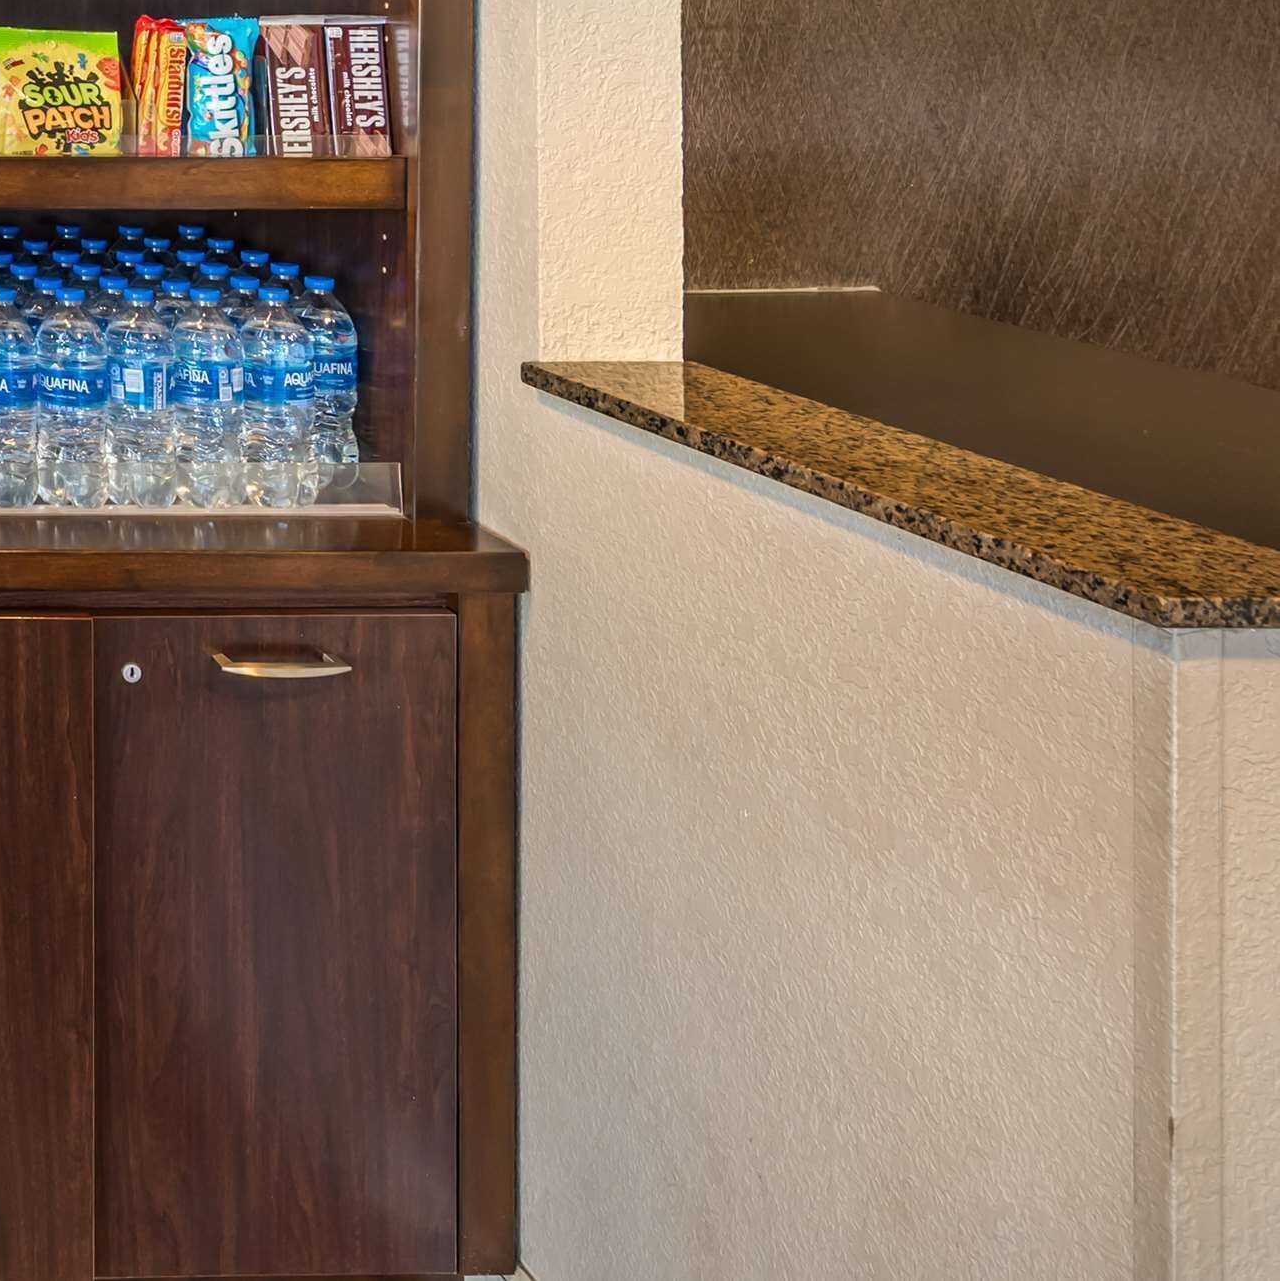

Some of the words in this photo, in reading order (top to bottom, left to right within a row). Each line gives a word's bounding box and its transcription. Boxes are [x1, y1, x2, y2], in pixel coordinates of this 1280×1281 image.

[166, 47, 186, 123] Starburst
[308, 68, 317, 105] chocolate
[342, 72, 351, 88] milk
[349, 30, 385, 127] HERSHEY'S
[23, 83, 102, 107] SOUR
[344, 90, 353, 126] chocolate
[23, 106, 112, 135] PATCH
[311, 105, 319, 122] milk
[65, 129, 99, 143] Kids
